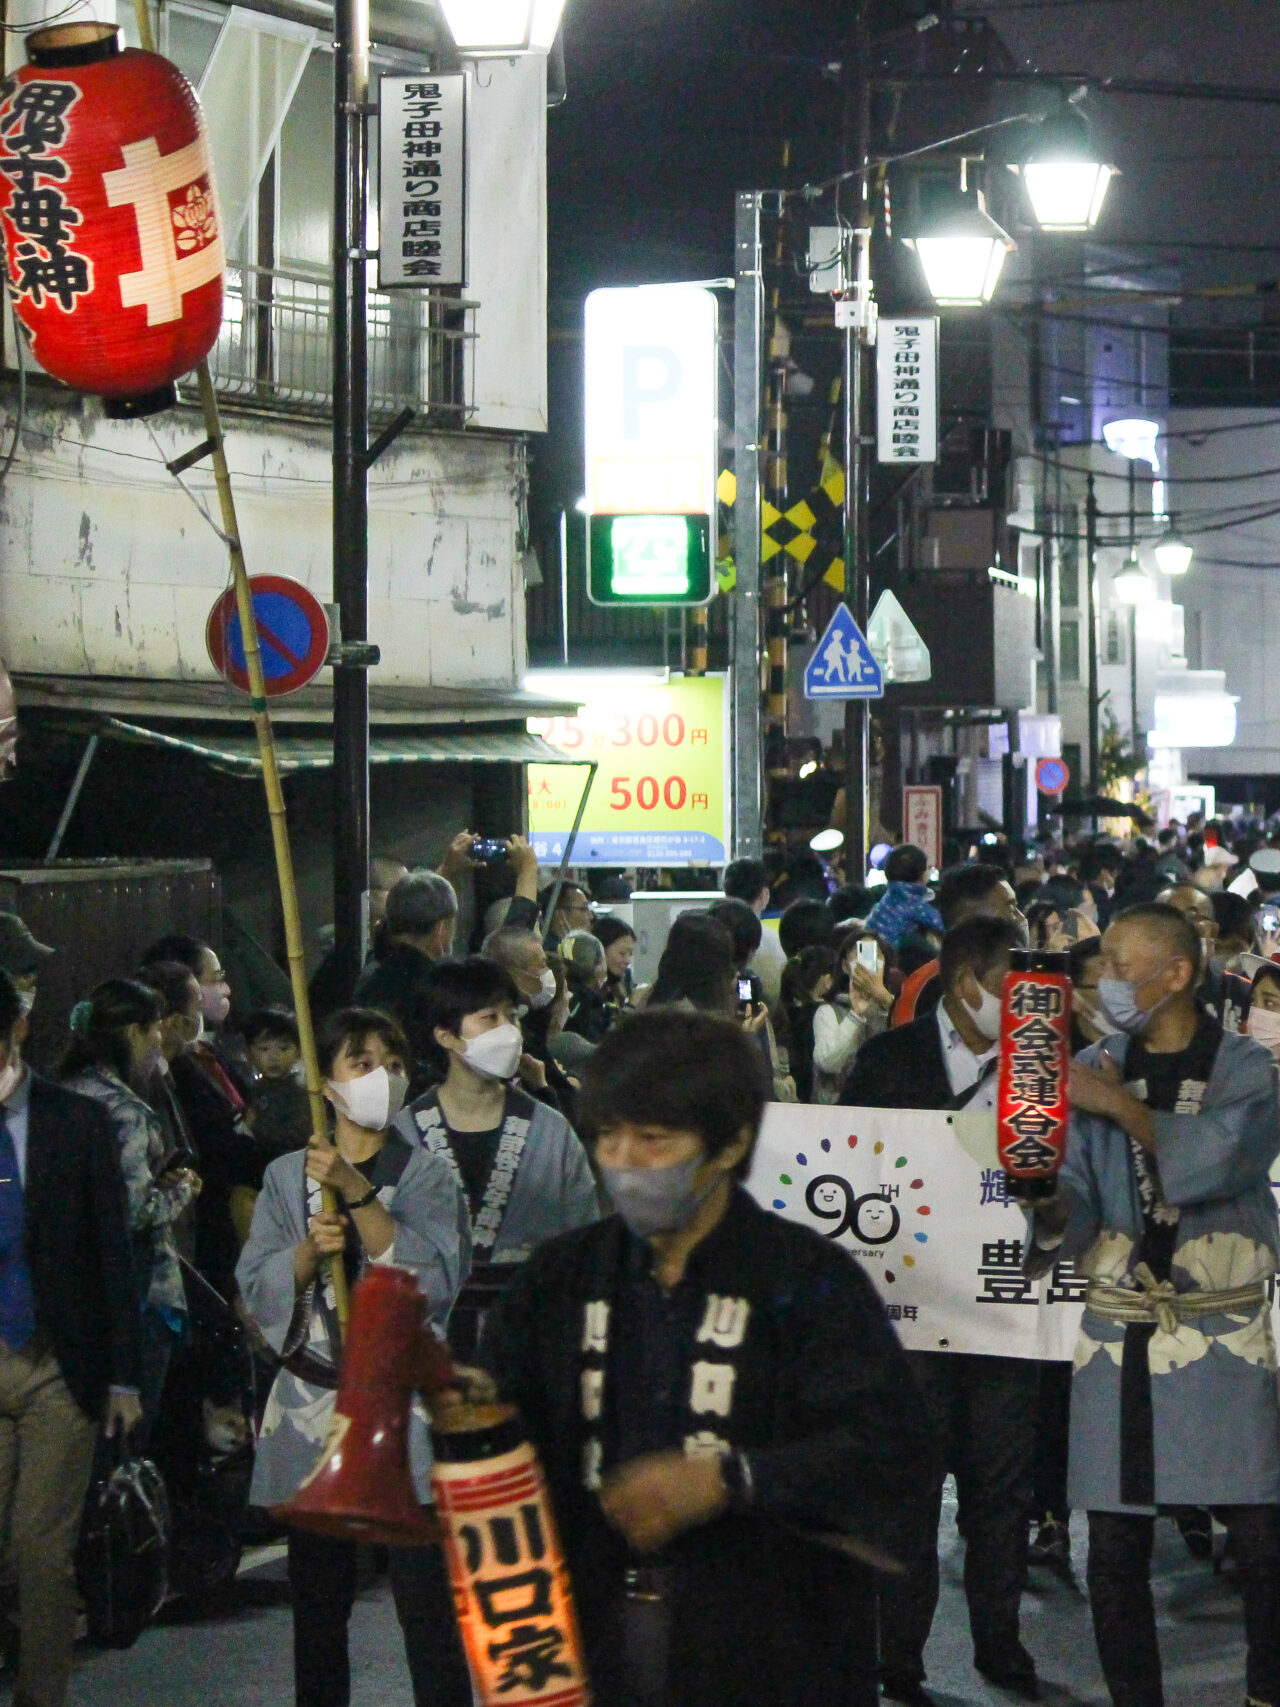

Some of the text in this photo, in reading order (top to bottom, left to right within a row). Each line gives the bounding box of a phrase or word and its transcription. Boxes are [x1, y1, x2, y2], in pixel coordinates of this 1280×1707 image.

[402, 83, 442, 276] 鬼子母神通り商店睦会
[622, 345, 684, 439] P
[609, 775, 708, 811] 500円
[1003, 979, 1065, 1169] 御会式連合会
[458, 1503, 572, 1695] 川口家
